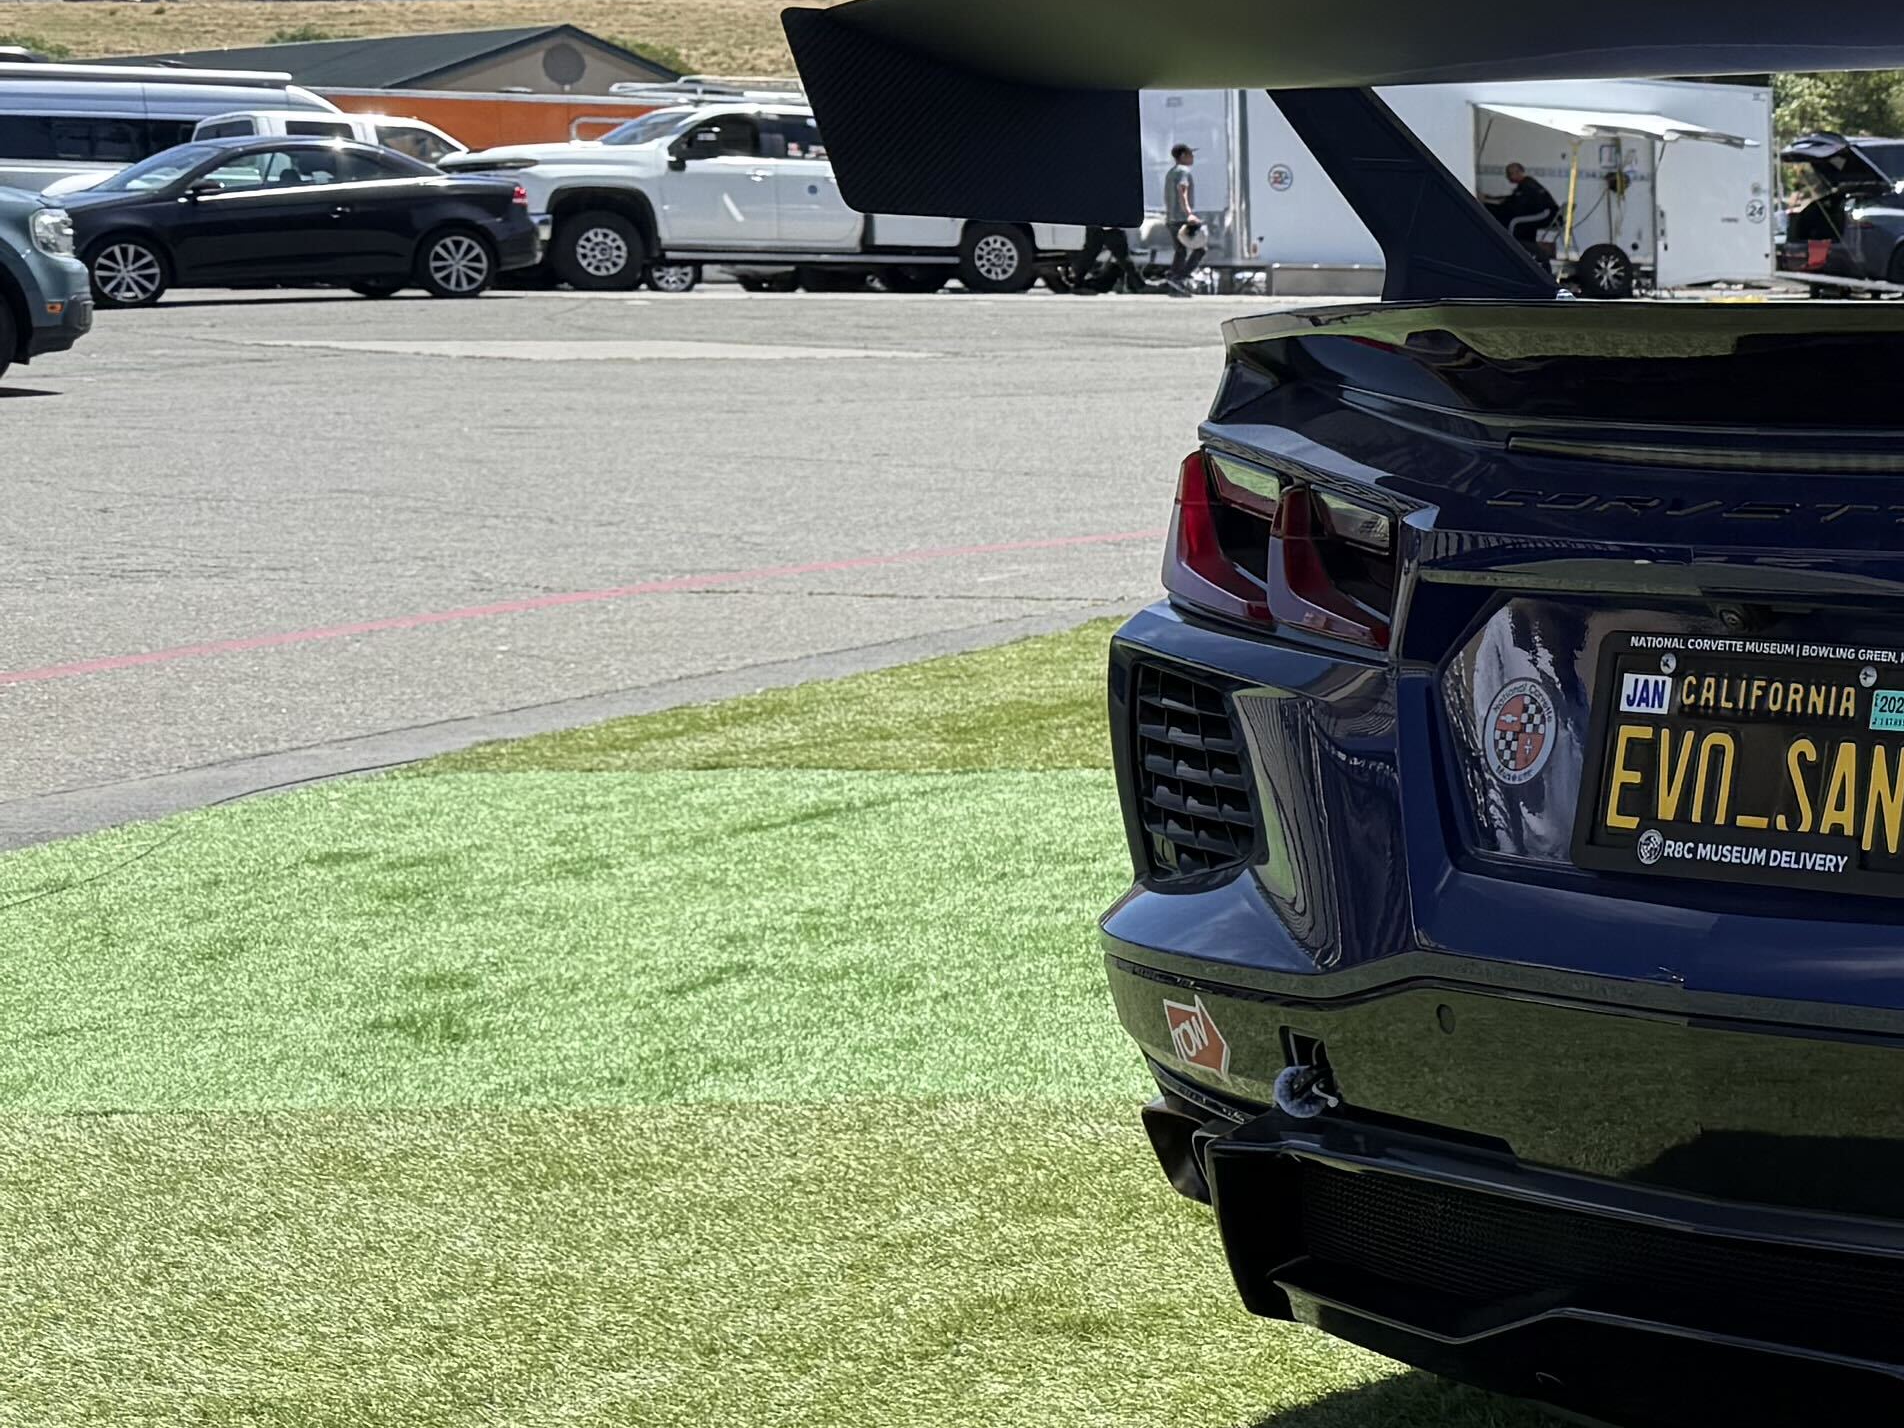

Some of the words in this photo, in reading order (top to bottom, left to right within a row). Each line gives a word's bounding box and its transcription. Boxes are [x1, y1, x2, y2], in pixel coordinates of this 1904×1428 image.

[1630, 636, 1686, 649] NATIONAL
[1687, 638, 1743, 652] CORVETTE
[1745, 642, 1795, 655] MUSEUM
[1802, 645, 1855, 660] BOWLING
[1858, 649, 1898, 664] GREEN,
[1626, 678, 1666, 709] JAN
[1681, 675, 1856, 717] CALIFORNIA
[1663, 842, 1693, 860] R8C
[1697, 843, 1766, 866] MUSEUM
[1769, 848, 1848, 872] DELIVERY
[1172, 1016, 1209, 1063] TOW
